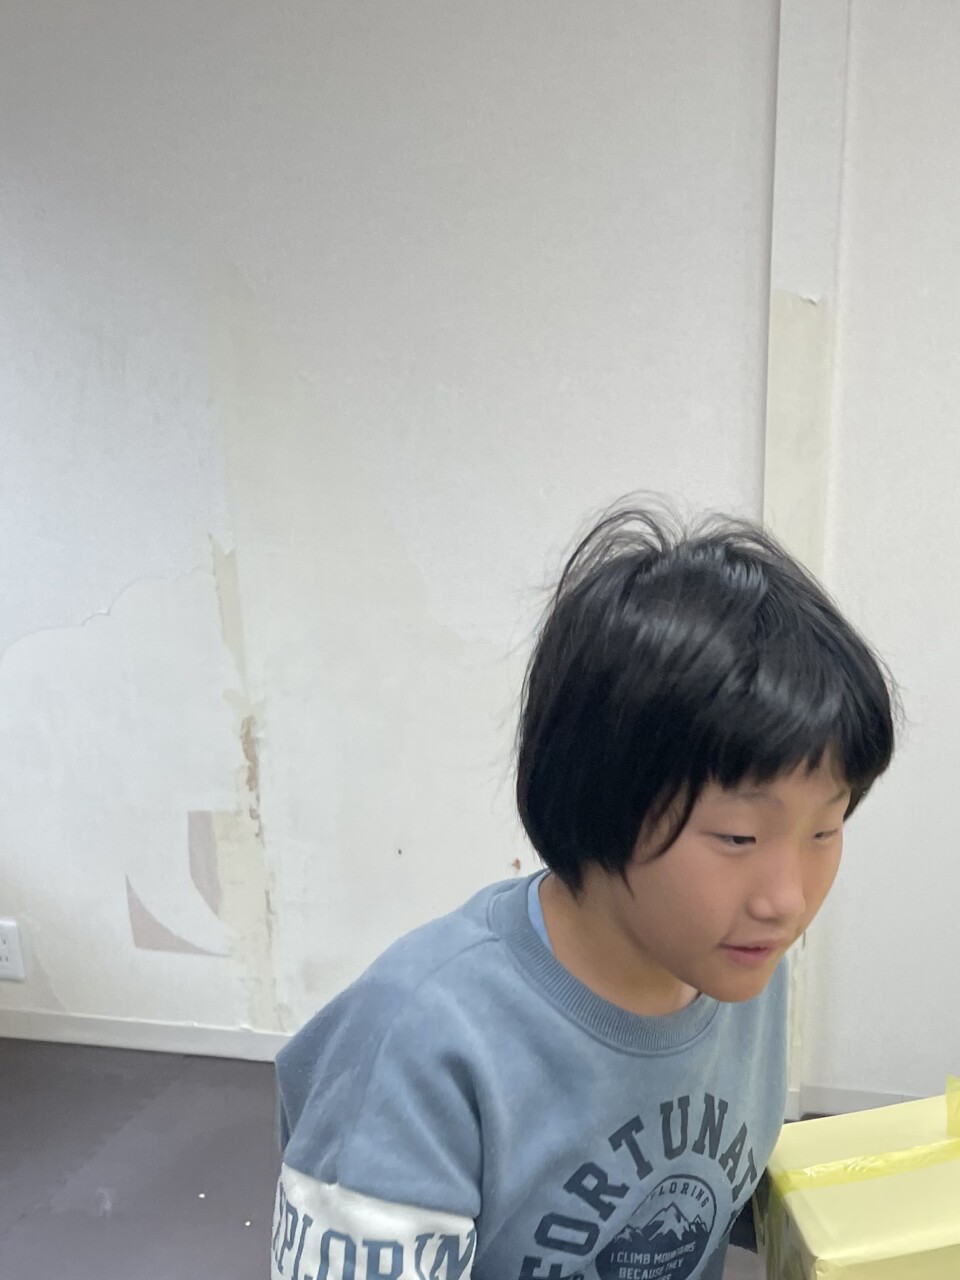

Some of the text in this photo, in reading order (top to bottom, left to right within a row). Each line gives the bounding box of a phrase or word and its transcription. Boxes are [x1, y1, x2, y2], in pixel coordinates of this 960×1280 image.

[616, 1251, 652, 1265] CLIMB
[618, 1258, 685, 1280] BECAUSE THEY
